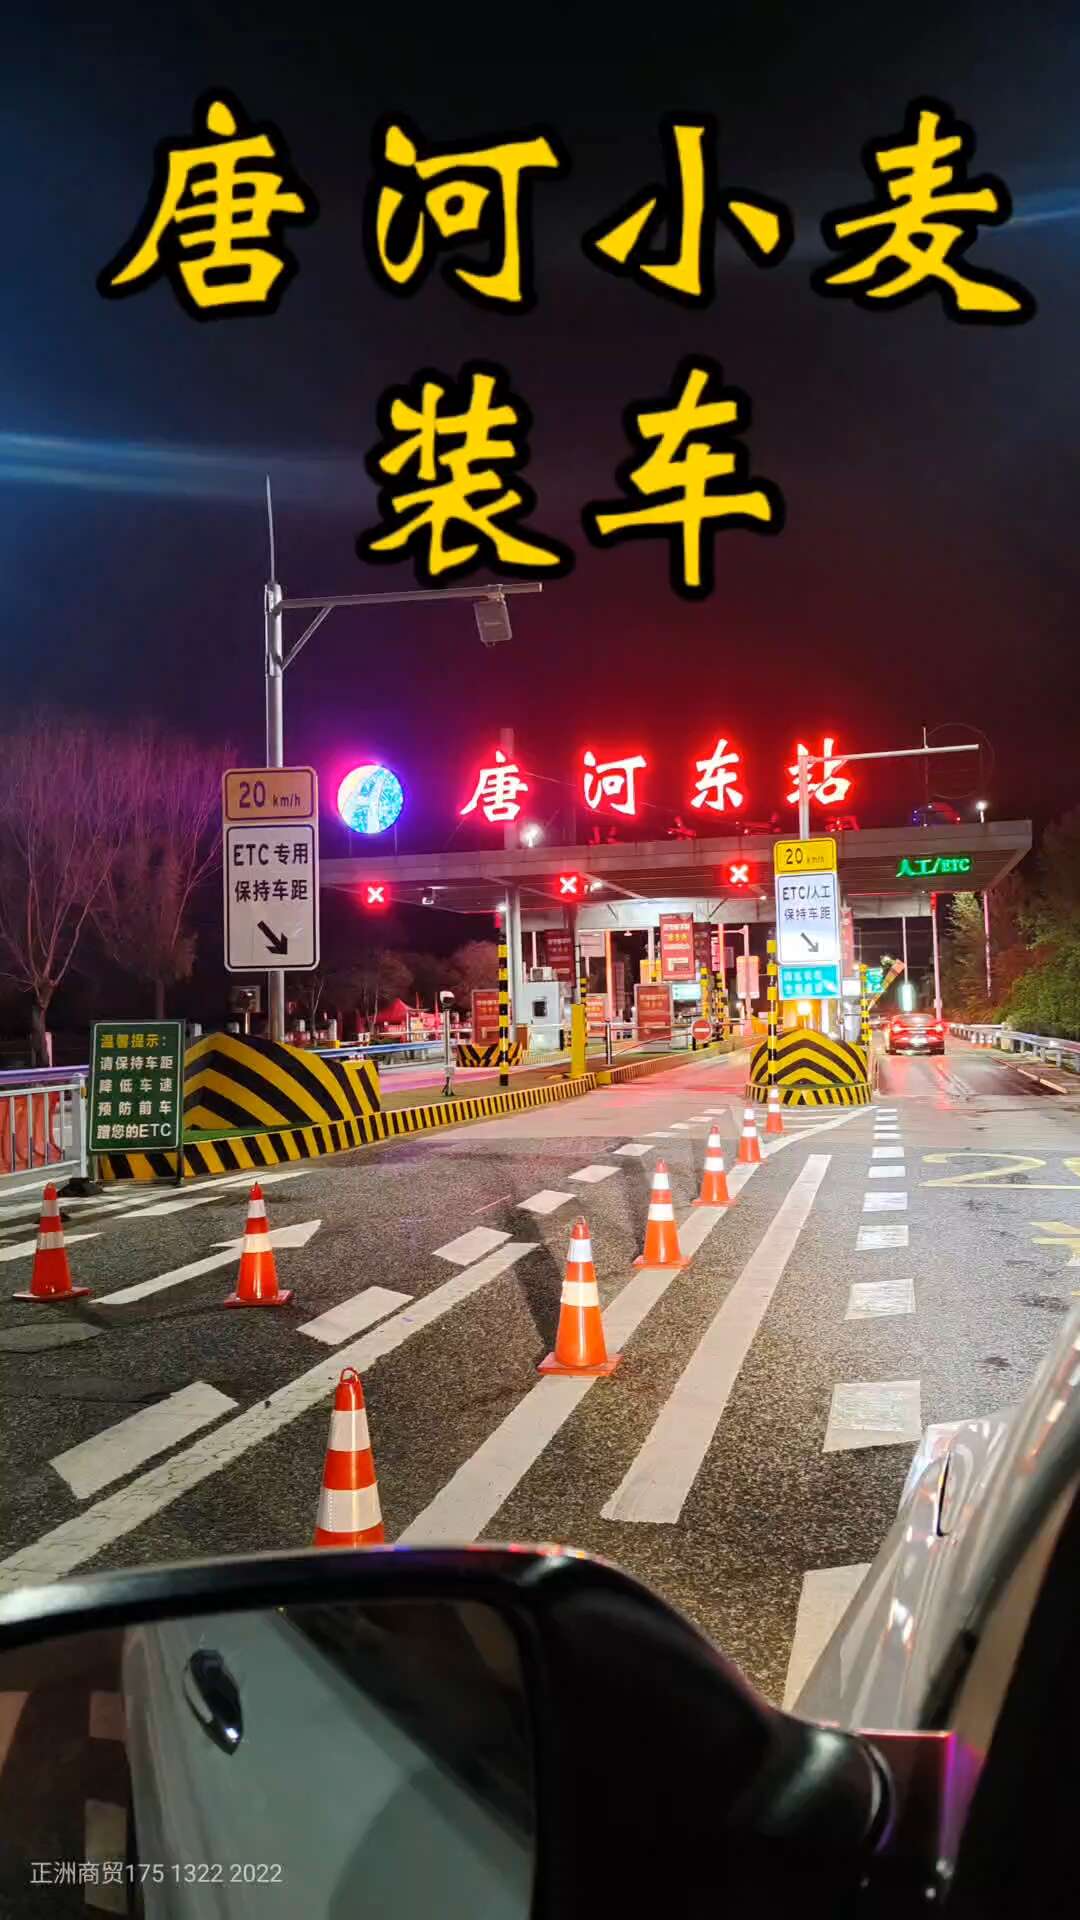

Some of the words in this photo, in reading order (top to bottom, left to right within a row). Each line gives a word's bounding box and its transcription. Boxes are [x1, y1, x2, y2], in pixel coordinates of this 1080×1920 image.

[459, 737, 853, 822] 唐河东站
[239, 781, 266, 809] 20
[272, 794, 301, 809] km/h
[785, 848, 804, 865] 20
[896, 857, 971, 878] 人工/ETC
[234, 879, 309, 902] 保持车距
[783, 884, 832, 901] ETC/人工
[784, 906, 832, 921] 保持车距
[100, 1055, 174, 1071] 请保持车距
[98, 1078, 173, 1094] 降低车速
[98, 1100, 172, 1117] 预防前车
